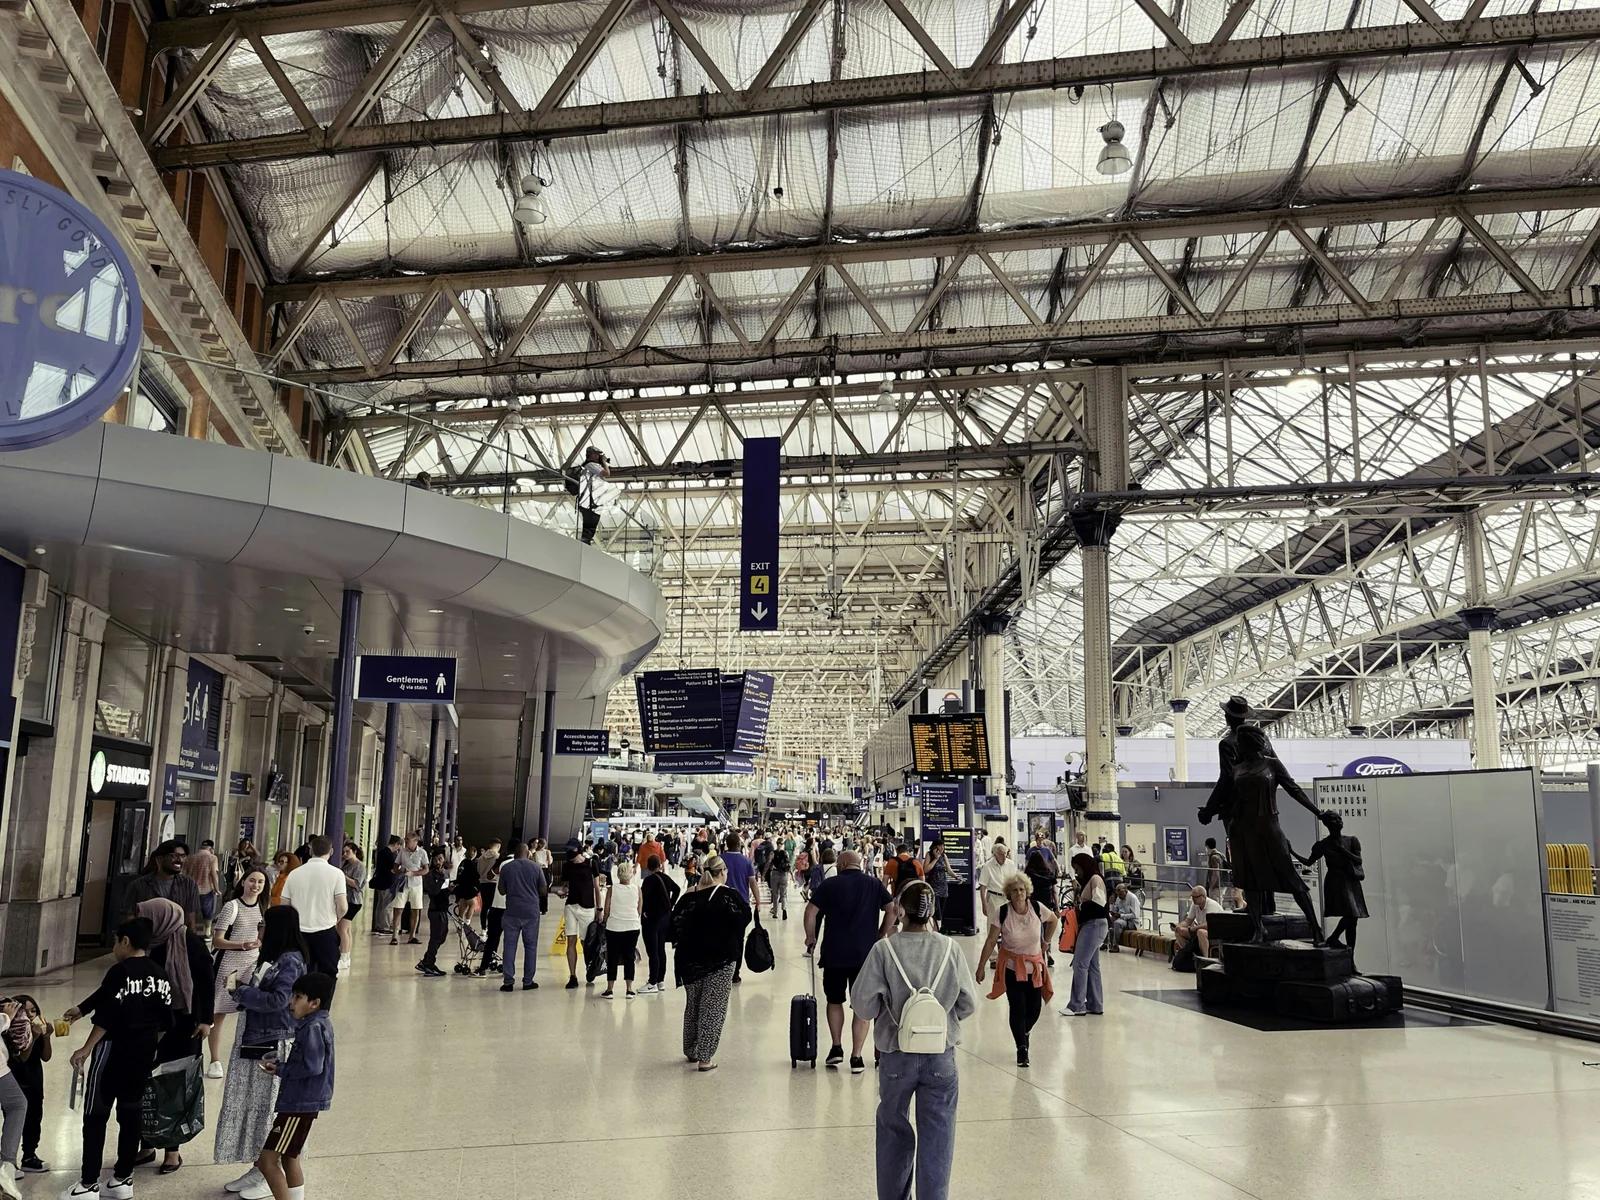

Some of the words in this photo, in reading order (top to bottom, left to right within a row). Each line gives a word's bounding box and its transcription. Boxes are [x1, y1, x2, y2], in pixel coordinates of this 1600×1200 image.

[750, 562, 770, 570] EXIT
[754, 578, 764, 592] 4
[386, 675, 428, 684] Gentlemen
[106, 764, 150, 786] STARBUCKS
[1331, 784, 1366, 792] NATIONAL
[1320, 797, 1367, 805] WINDRUSH
